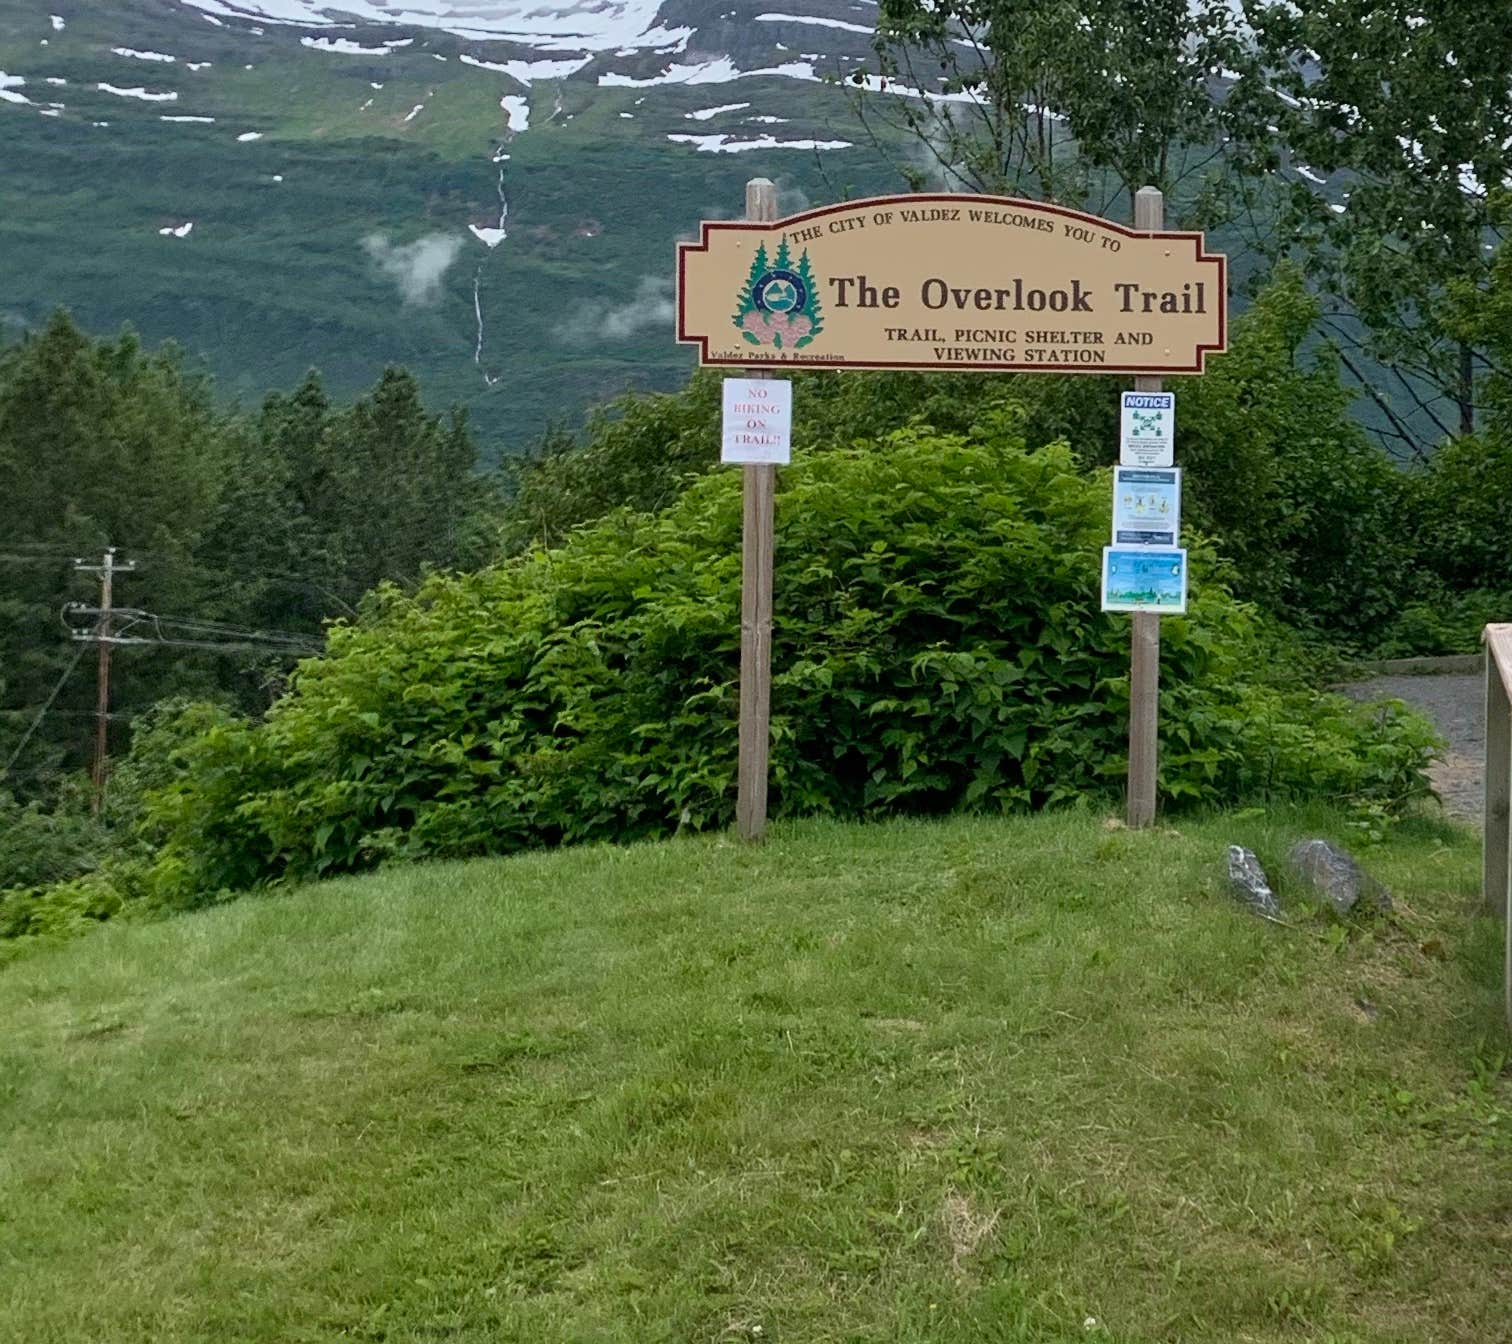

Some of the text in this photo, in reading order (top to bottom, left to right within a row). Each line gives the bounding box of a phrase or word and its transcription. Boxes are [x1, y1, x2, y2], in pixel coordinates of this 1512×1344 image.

[789, 208, 1122, 253] THE CITY OF VALDEZ WELCOMES YOU TO
[828, 275, 1208, 315] The Overlook Trail
[883, 327, 1154, 346] TRAIL, PICNIC SHELTER AND
[711, 350, 744, 360] Valdez
[748, 351, 776, 360] Parks
[793, 352, 845, 361] Recreation
[933, 347, 1106, 363] VIEWING STATION
[748, 388, 768, 399] NO
[1125, 396, 1170, 408] NOTICE
[746, 418, 767, 430] ON
